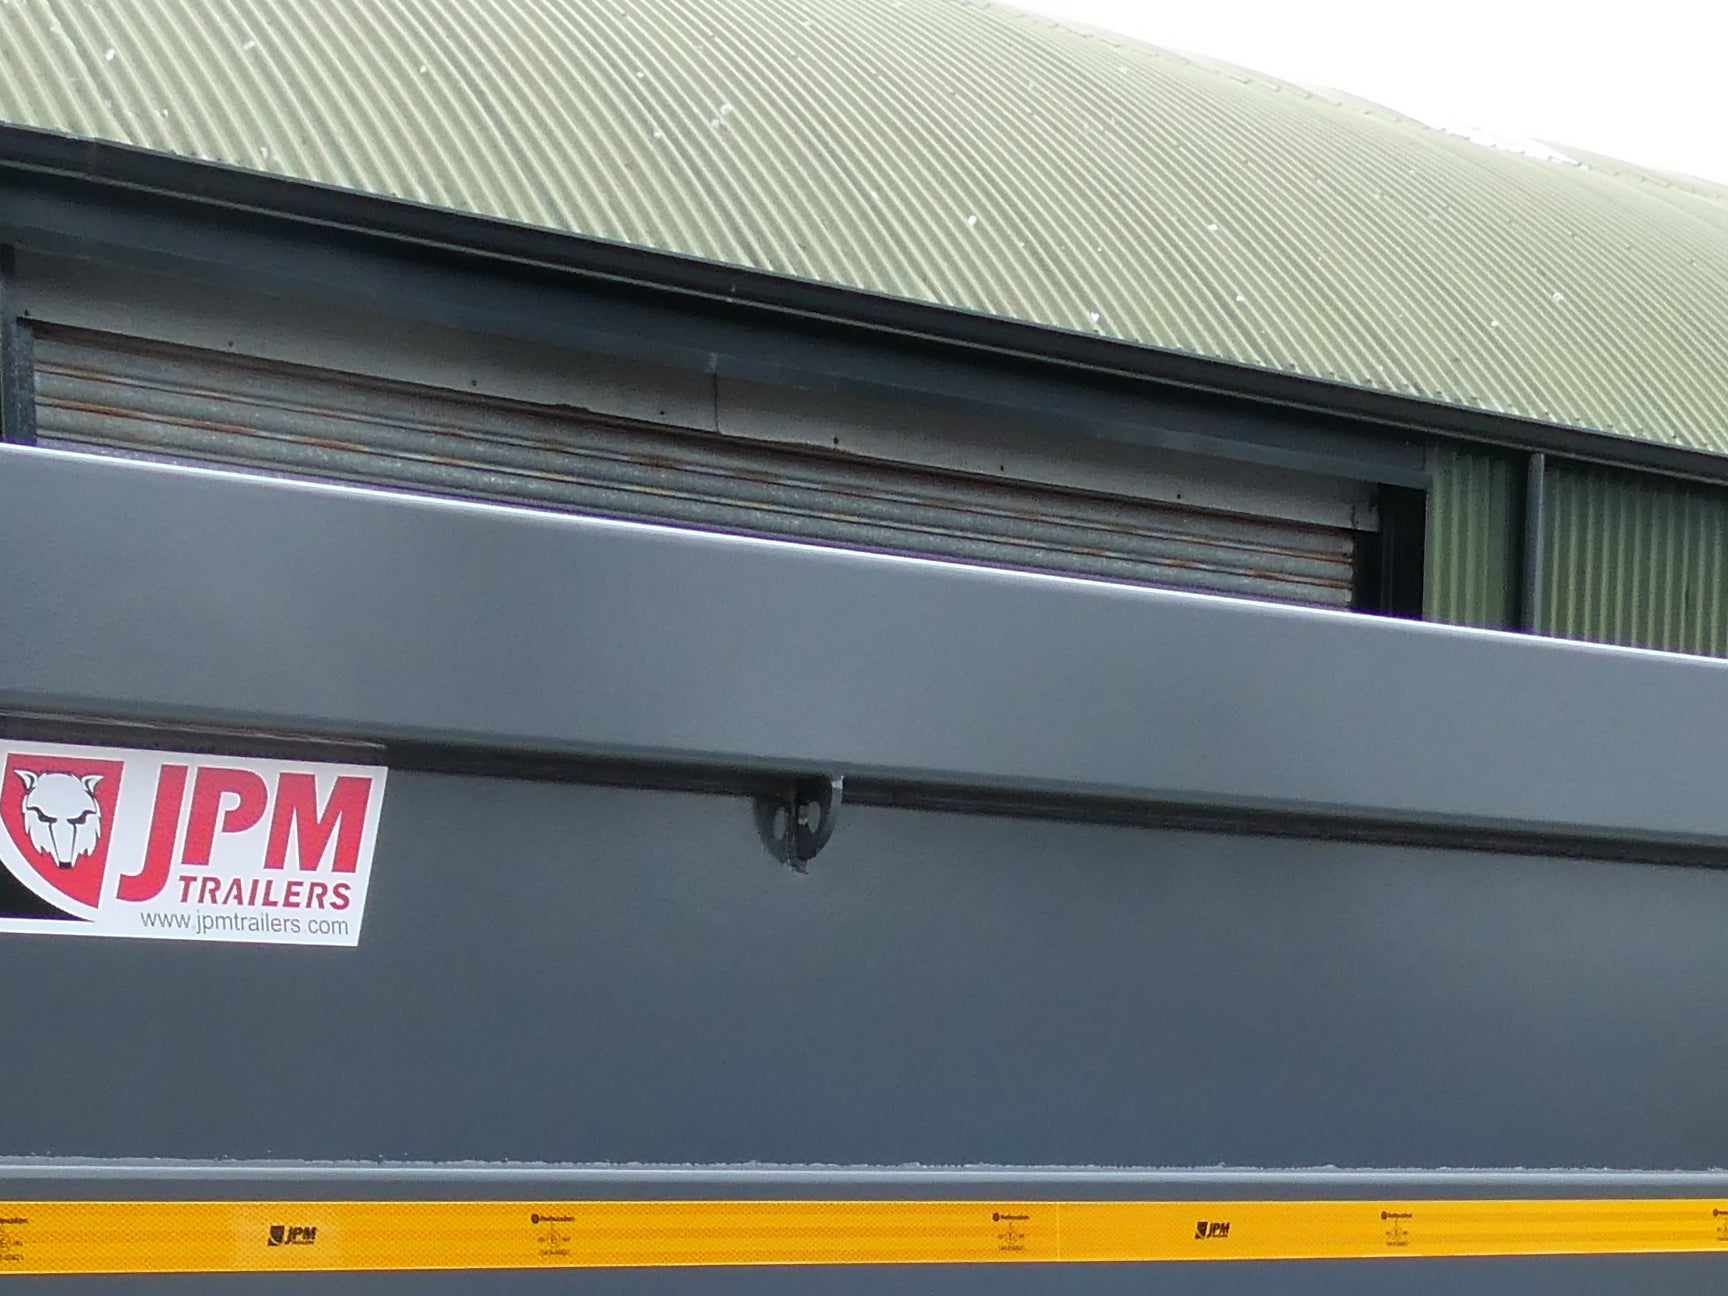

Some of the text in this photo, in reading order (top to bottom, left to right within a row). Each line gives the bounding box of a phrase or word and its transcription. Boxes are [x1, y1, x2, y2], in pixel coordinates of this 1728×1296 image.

[115, 763, 373, 903] JPM
[177, 875, 352, 911] TRAILERS
[140, 910, 350, 937] www.jpmtrailers.com
